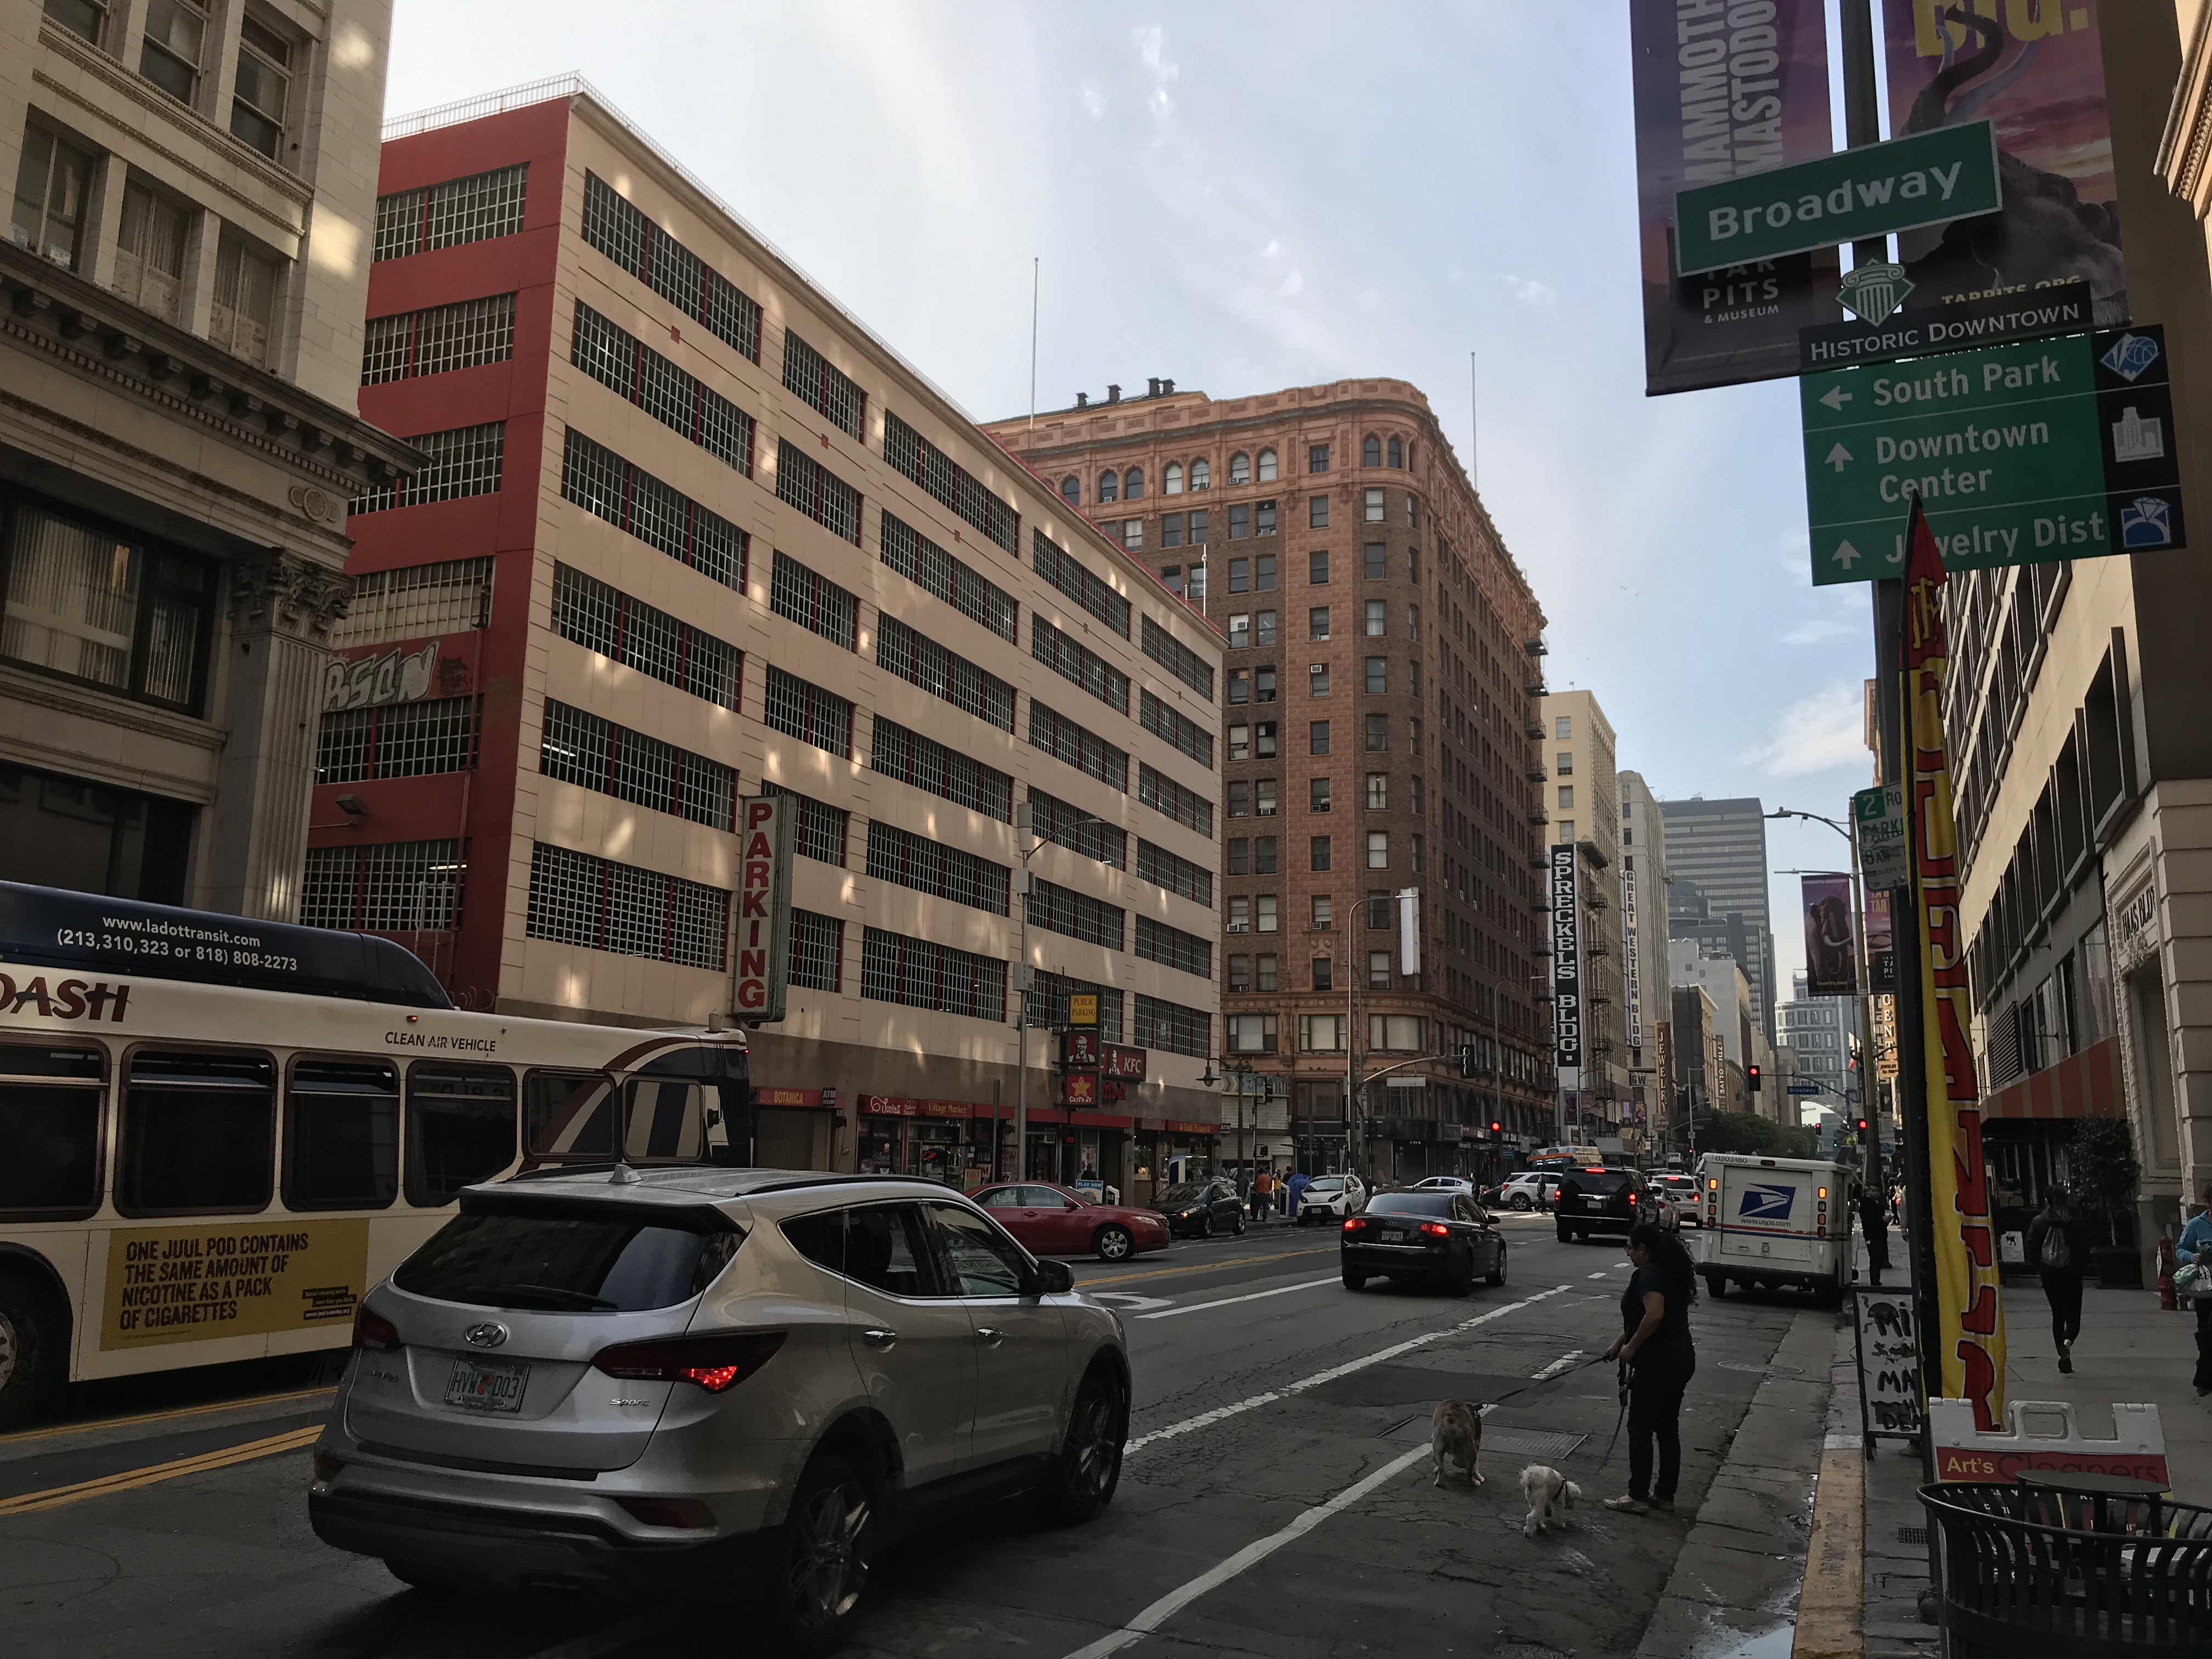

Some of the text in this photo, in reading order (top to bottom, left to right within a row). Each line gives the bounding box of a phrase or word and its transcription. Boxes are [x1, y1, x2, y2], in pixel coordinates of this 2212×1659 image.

[1708, 161, 1962, 241] Broadway
[1703, 278, 1779, 309] PITS
[1704, 305, 1779, 324] & MUSEUM
[1810, 329, 1919, 360] HISTORIC
[1928, 303, 2080, 342] DOWNTOWN
[1874, 355, 2061, 406] South Park
[1876, 421, 2050, 465] Downtown
[1880, 467, 1993, 503] Center
[1885, 511, 2106, 563] Jwelry Dist
[1863, 791, 1902, 816] 2 HO
[737, 803, 773, 1008] PARKING
[1554, 851, 1577, 980] SPRECKELS
[102, 917, 261, 947] www.ladottransit.com
[174, 945, 190, 958] or
[196, 946, 228, 965] 818)
[233, 951, 297, 971] 808-2273
[1626, 871, 1641, 1046] GREAT WESTERN BLDG
[1071, 1008, 1096, 1017] PARKING
[1073, 998, 1094, 1006] PUBLIC
[385, 1031, 496, 1052] CLEAN AIR VEHICLE
[1123, 1057, 1142, 1074] KFC
[1632, 1074, 1646, 1085] GW
[1658, 1032, 1668, 1113] JEWELRY
[774, 1091, 803, 1104] BOTANICA
[928, 1102, 946, 1114] Village
[947, 1104, 967, 1114] Market
[1716, 1155, 1747, 1164] 0203180
[1741, 1218, 1791, 1227] www.usps.com
[126, 1232, 308, 1261] ONE JUUL POD CONTAINS
[124, 1254, 290, 1284] THE SAME AMOUNT OF
[122, 1277, 273, 1307] NICOTINE AS A PACK
[120, 1300, 238, 1330] OF CIGARETTES
[610, 1398, 650, 1407] Sport
[1946, 1457, 1994, 1474] Art's
